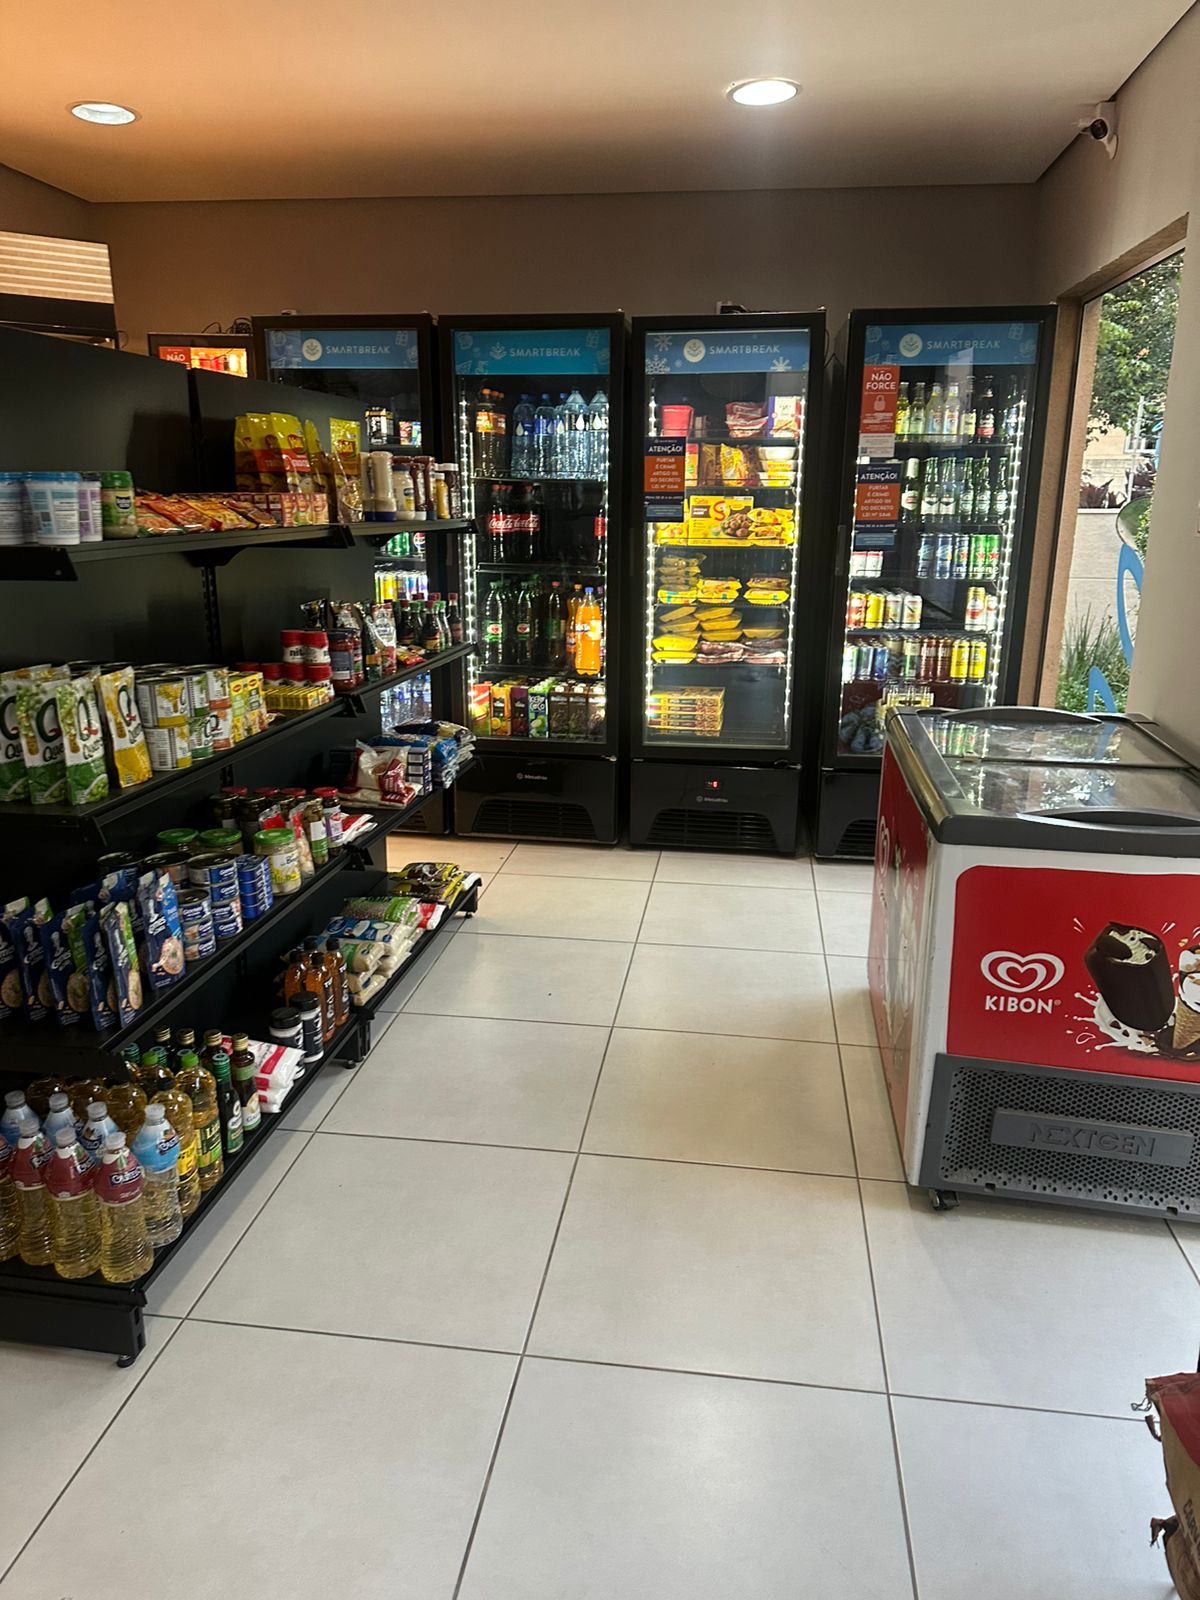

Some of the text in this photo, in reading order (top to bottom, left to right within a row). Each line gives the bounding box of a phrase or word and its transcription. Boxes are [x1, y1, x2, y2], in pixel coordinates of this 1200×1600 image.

[326, 345, 391, 355] SMARTBREAK
[709, 344, 780, 355] SMARTBREAK
[927, 339, 1000, 350] SMARTBREAK
[166, 351, 186, 361] NÃO
[509, 346, 581, 358] SMARTBREAK
[871, 370, 892, 381] NÃO
[866, 381, 897, 390] FORCE
[649, 444, 682, 454] ATENÇÃO!
[861, 471, 897, 481] ATENÇÃO!
[984, 995, 1055, 1015] KIBON
[1029, 1121, 1156, 1158] NEXTGEN
